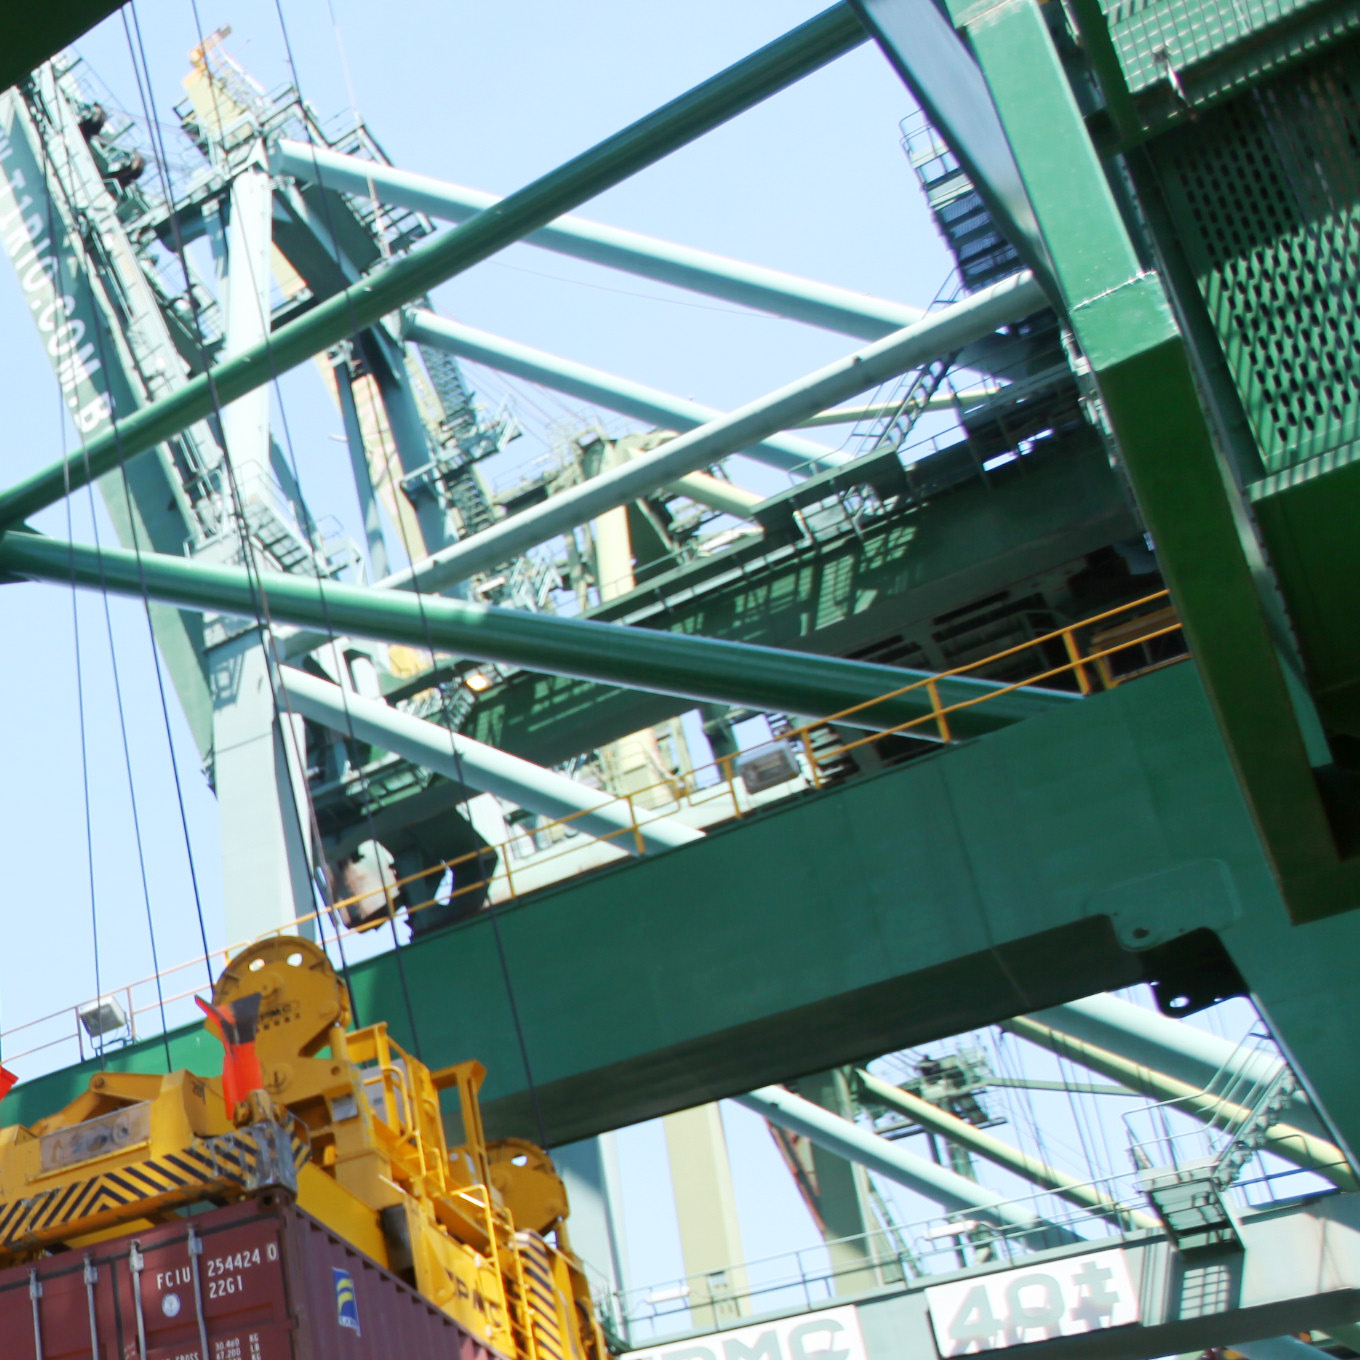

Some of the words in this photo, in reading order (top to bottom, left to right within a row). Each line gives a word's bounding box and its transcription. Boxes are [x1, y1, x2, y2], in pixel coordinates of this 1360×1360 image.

[156, 1266, 191, 1290] FCIU
[207, 1247, 261, 1277] 254424
[208, 1275, 243, 1299] 22G1
